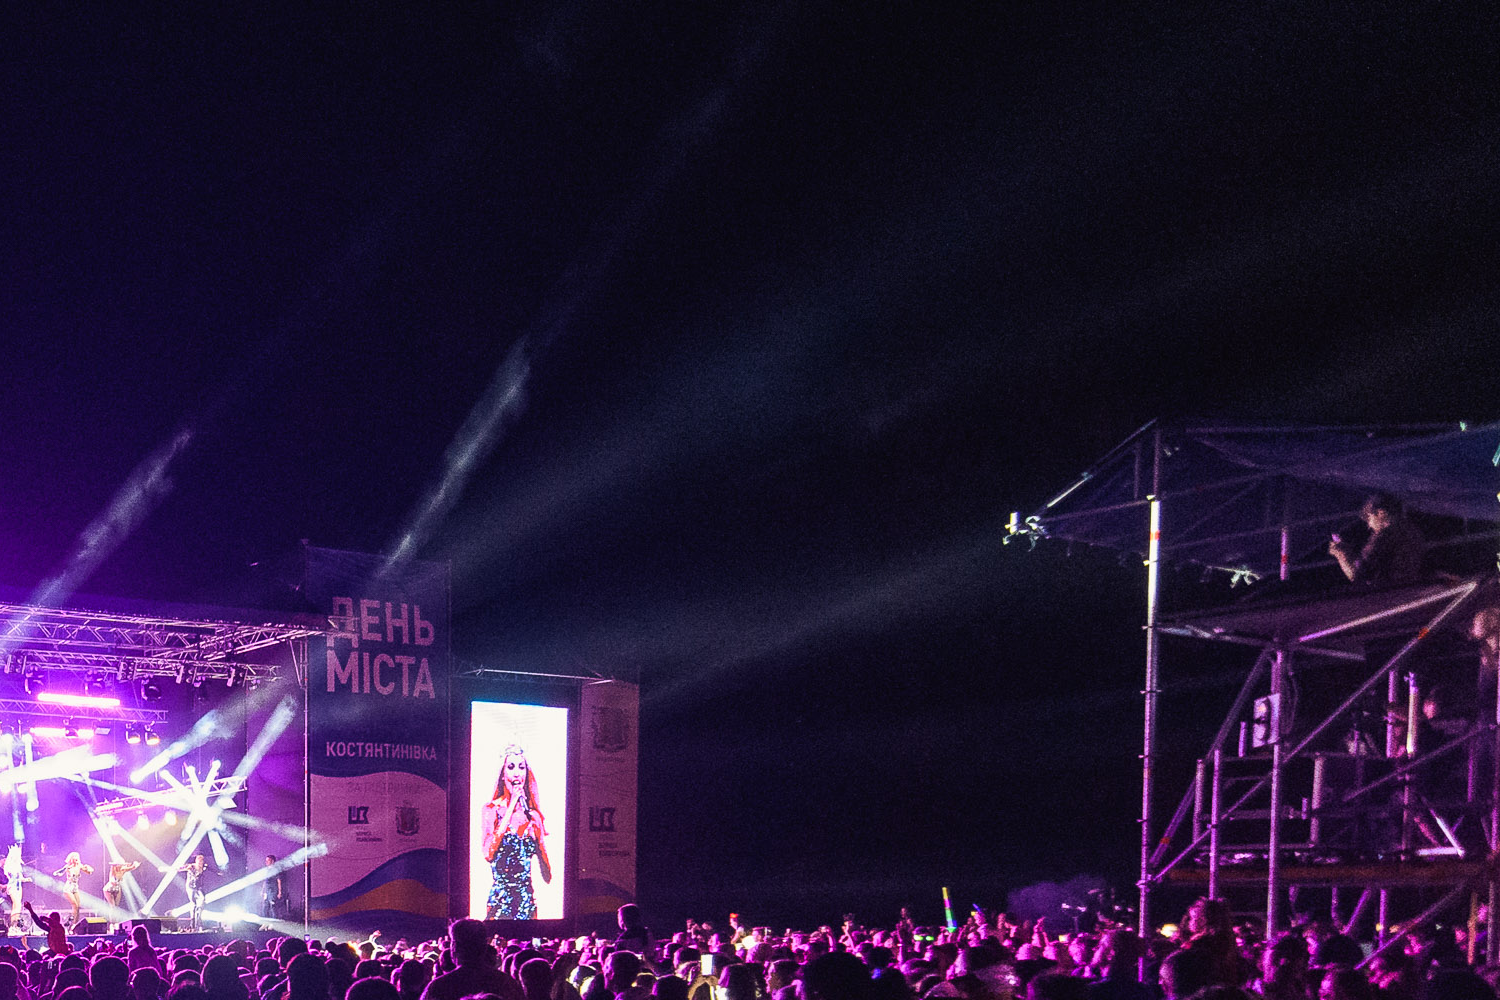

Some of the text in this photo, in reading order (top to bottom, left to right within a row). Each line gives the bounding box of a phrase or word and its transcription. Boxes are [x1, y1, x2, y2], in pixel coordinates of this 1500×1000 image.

[326, 596, 435, 648] ДЕНЬ
[326, 649, 436, 699] МІСТА
[326, 741, 437, 760] КОСТЯНТИНІВКА
